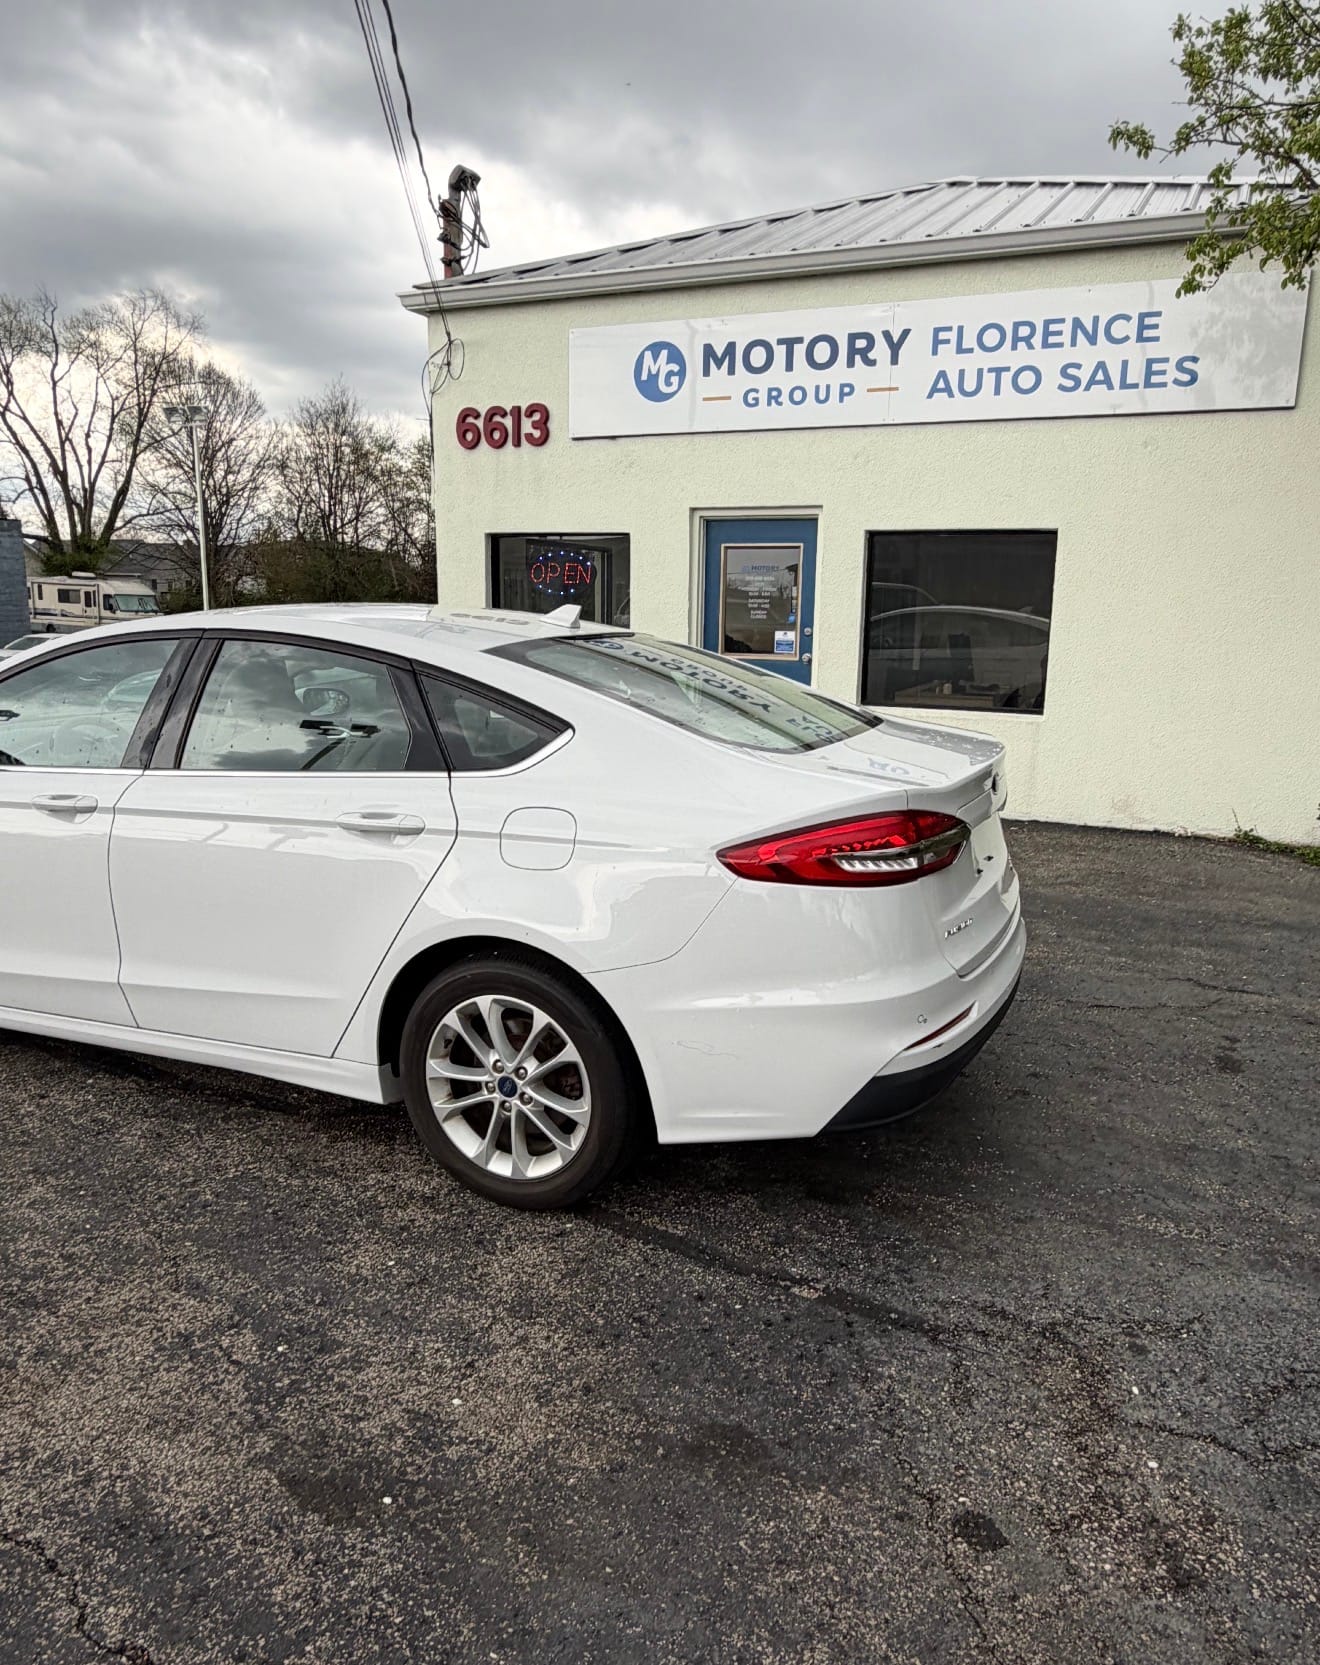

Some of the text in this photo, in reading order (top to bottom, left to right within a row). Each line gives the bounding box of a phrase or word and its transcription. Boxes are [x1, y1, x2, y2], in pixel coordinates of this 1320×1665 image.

[702, 328, 912, 378] MOTORY
[931, 310, 1163, 357] FLORENCE
[640, 348, 680, 394] MG
[926, 355, 1201, 400] AUTO SALES
[742, 382, 856, 409] GROUP
[456, 403, 550, 450] 6613
[530, 562, 593, 585] OPEN
